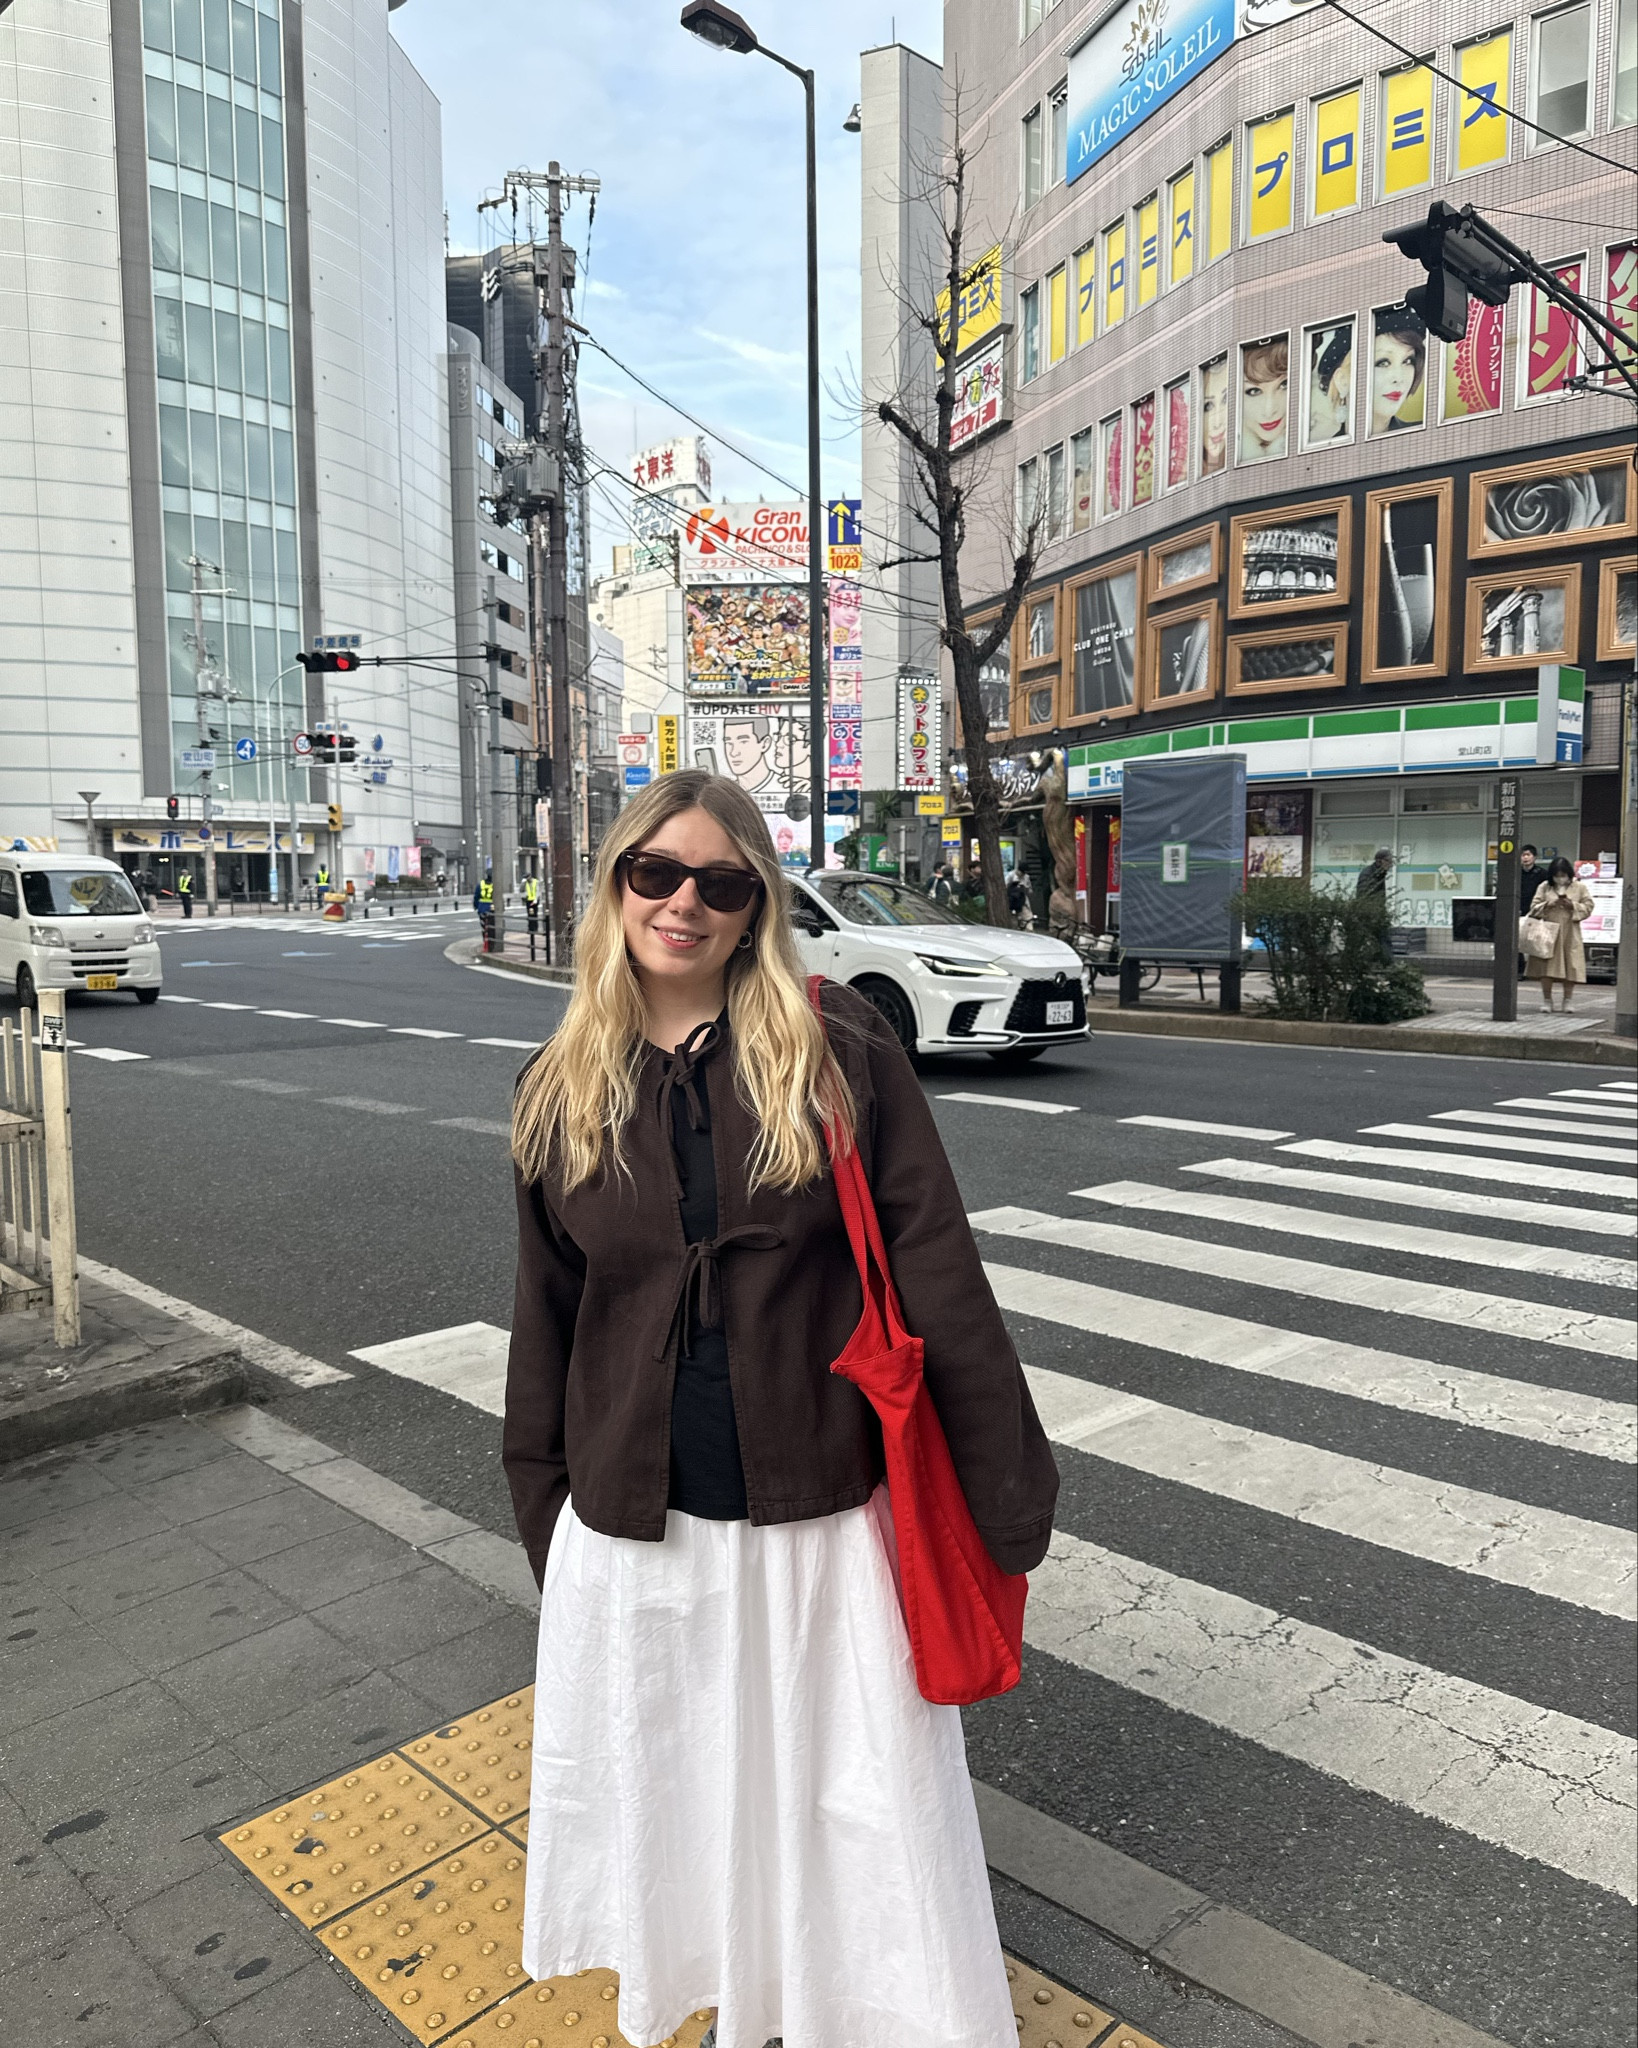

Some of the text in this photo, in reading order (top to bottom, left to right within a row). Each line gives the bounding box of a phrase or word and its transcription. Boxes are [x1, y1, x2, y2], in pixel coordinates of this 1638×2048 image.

[1078, 16, 1221, 163] MAGIC SOLEIL
[1254, 81, 1502, 199] プロミス
[1080, 209, 1193, 314] プロミス
[972, 406, 987, 430] 7F
[634, 449, 673, 487] 大東洋
[753, 508, 801, 525] Gran
[734, 526, 810, 544] KICON
[736, 544, 786, 555] PACHINCO
[794, 545, 810, 553] SLO
[830, 555, 859, 569] 1023
[1073, 627, 1134, 652] CLUB ONE CHAN
[751, 670, 810, 680] おかげさまで2
[693, 704, 781, 715] #UPDATE HIV
[1558, 708, 1581, 724] FamilyMart
[912, 687, 928, 775] ネットカフェ
[299, 738, 310, 750] 50
[1458, 746, 1493, 756] 堂山町店
[183, 751, 215, 762] 堂山町
[1104, 766, 1123, 785] Fam
[920, 801, 943, 809] プロミス
[1500, 781, 1516, 836] 新御堂筋
[1052, 1010, 1072, 1023] 22-63
